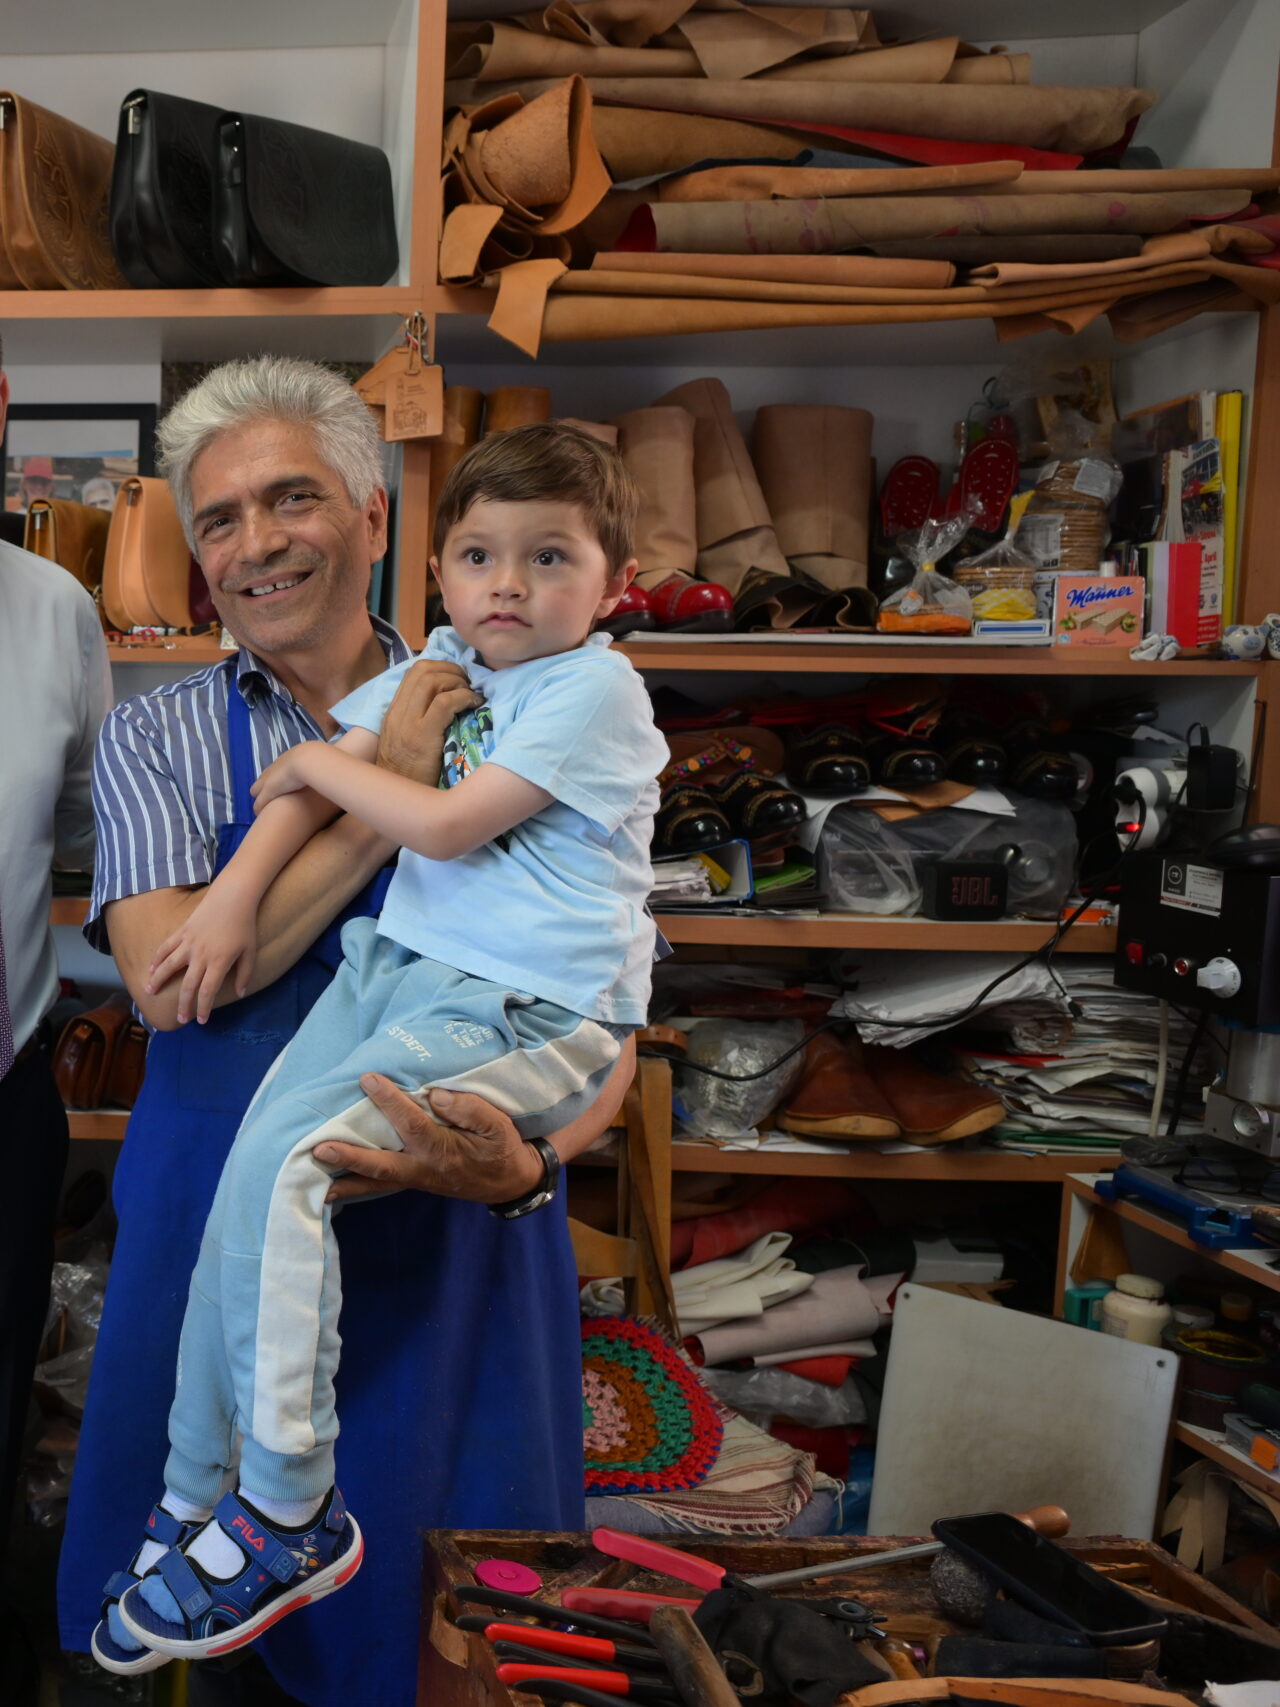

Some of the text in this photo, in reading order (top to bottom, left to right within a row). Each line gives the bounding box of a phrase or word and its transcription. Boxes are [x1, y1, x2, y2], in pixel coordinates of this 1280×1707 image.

[1066, 584, 1135, 608] Manner
[952, 877, 998, 906] JBL
[232, 1515, 265, 1552] FILA
